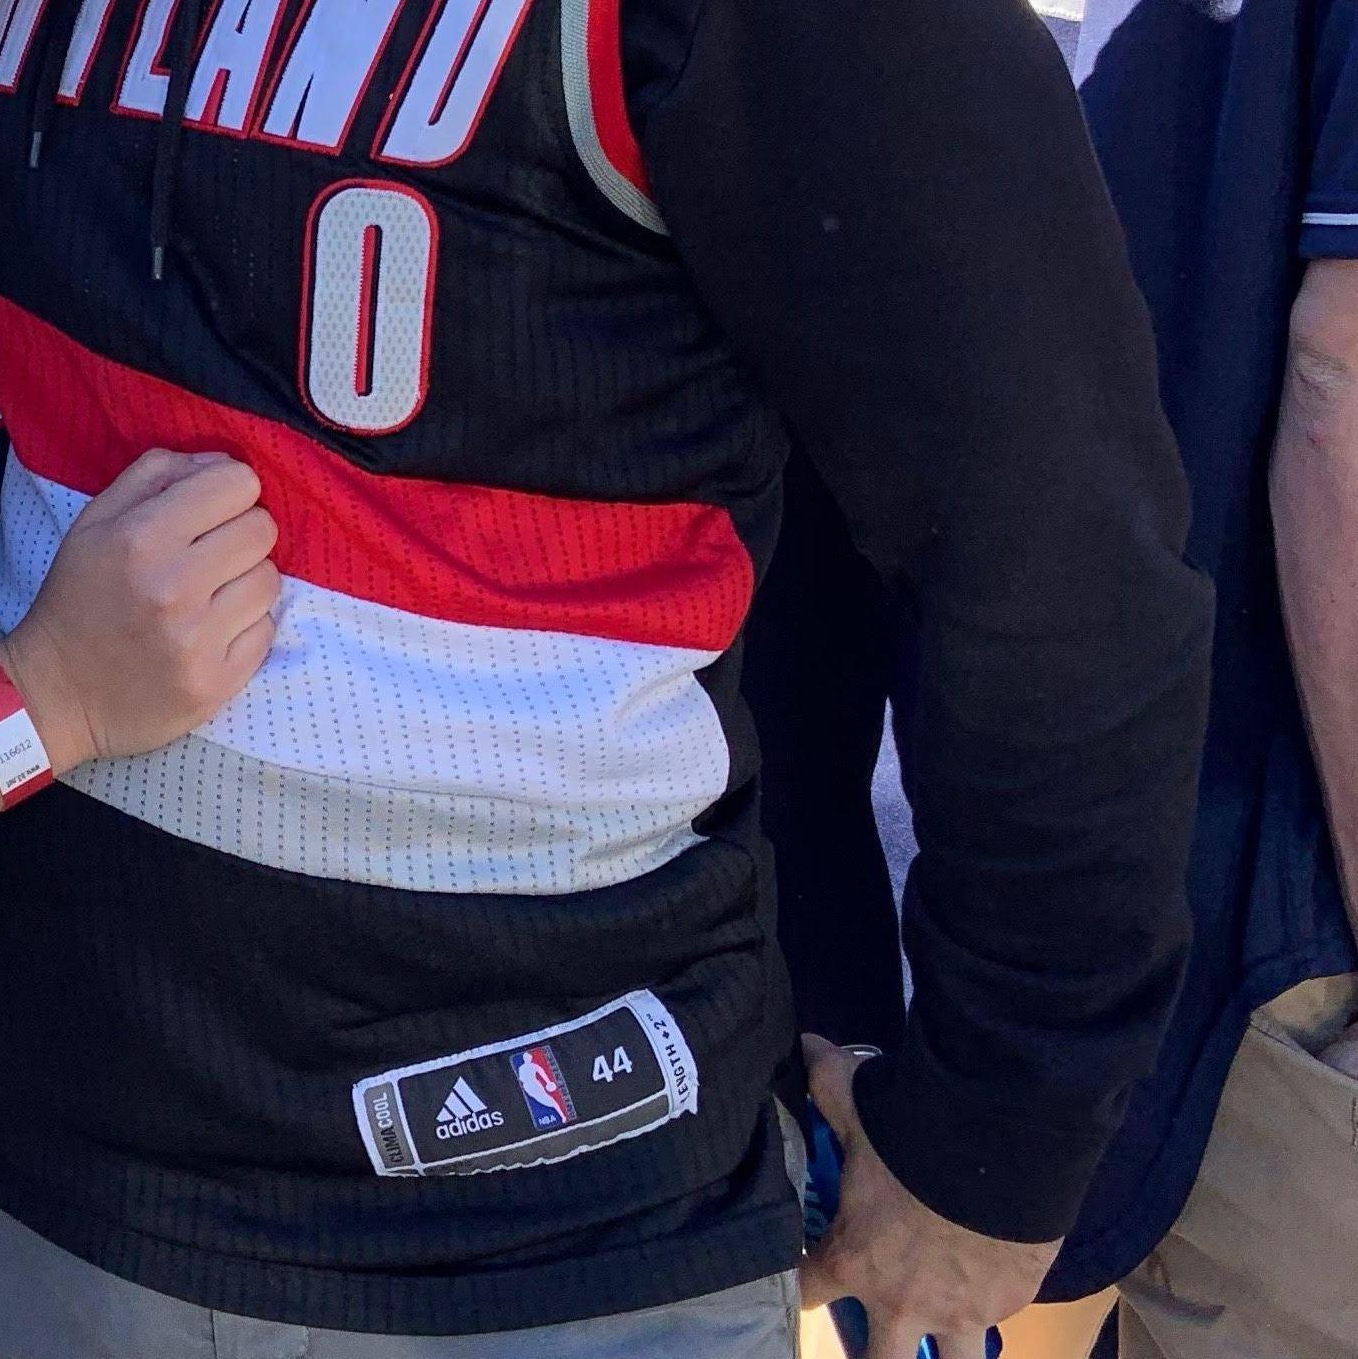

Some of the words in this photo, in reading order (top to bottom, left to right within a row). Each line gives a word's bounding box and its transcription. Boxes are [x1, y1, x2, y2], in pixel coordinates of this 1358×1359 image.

[298, 178, 440, 437] 0
[592, 1045, 633, 1083] 44
[372, 1091, 404, 1162] CLIMACOOL
[435, 1110, 504, 1140] adidas
